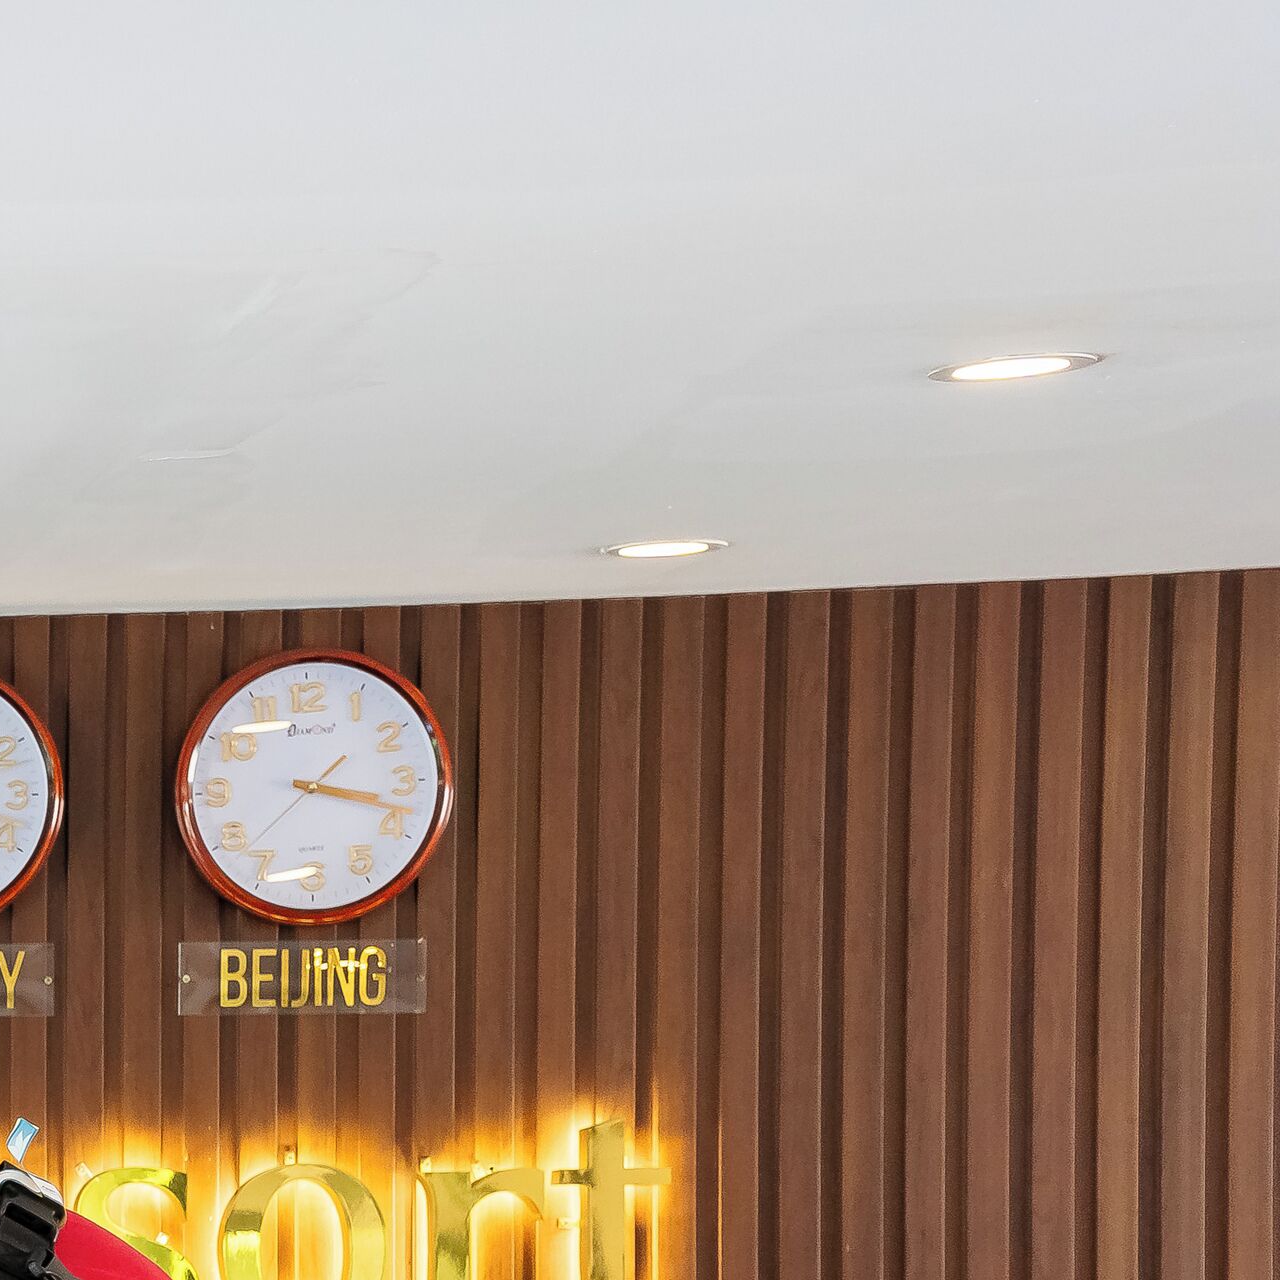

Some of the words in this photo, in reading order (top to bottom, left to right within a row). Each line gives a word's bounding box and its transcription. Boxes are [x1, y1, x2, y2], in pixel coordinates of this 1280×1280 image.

[252, 696, 277, 722] 11
[291, 682, 326, 713] 12
[349, 691, 360, 721] 1
[221, 732, 257, 762] 10
[376, 721, 401, 752] 2
[5, 780, 28, 810] 3
[206, 778, 231, 808] 9
[392, 765, 415, 796] 3
[221, 821, 247, 851] 8
[378, 809, 404, 840] 4
[249, 850, 275, 881] 7
[349, 845, 373, 875] 5
[299, 862, 325, 892] 6
[219, 945, 387, 1008] BEIJING
